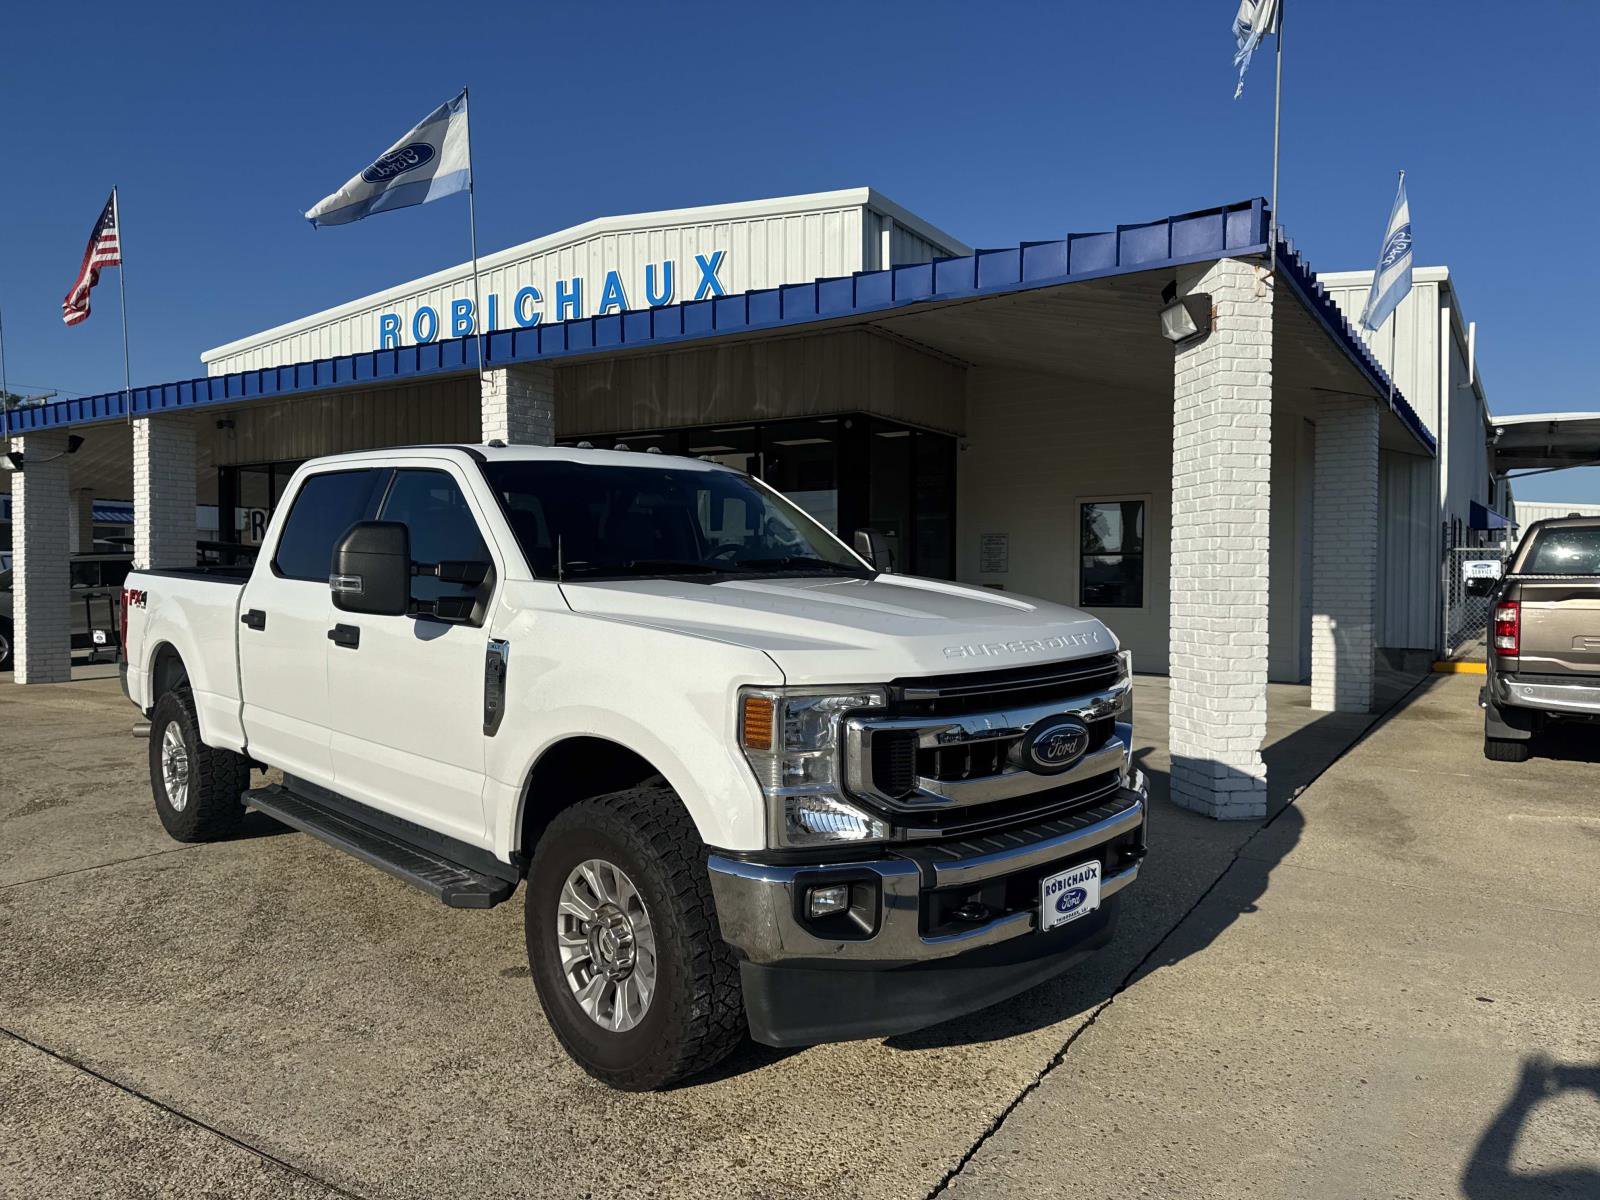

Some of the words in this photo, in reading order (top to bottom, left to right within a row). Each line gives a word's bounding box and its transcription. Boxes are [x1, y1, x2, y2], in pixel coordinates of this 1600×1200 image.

[379, 250, 727, 350] ROBICHAUX
[129, 588, 148, 606] FX4
[944, 639, 1045, 659] SUPER
[1044, 631, 1099, 649] DUTY
[1047, 733, 1078, 758] Ford
[1046, 868, 1097, 896] ROBICHAUX
[1062, 891, 1081, 909] Ford
